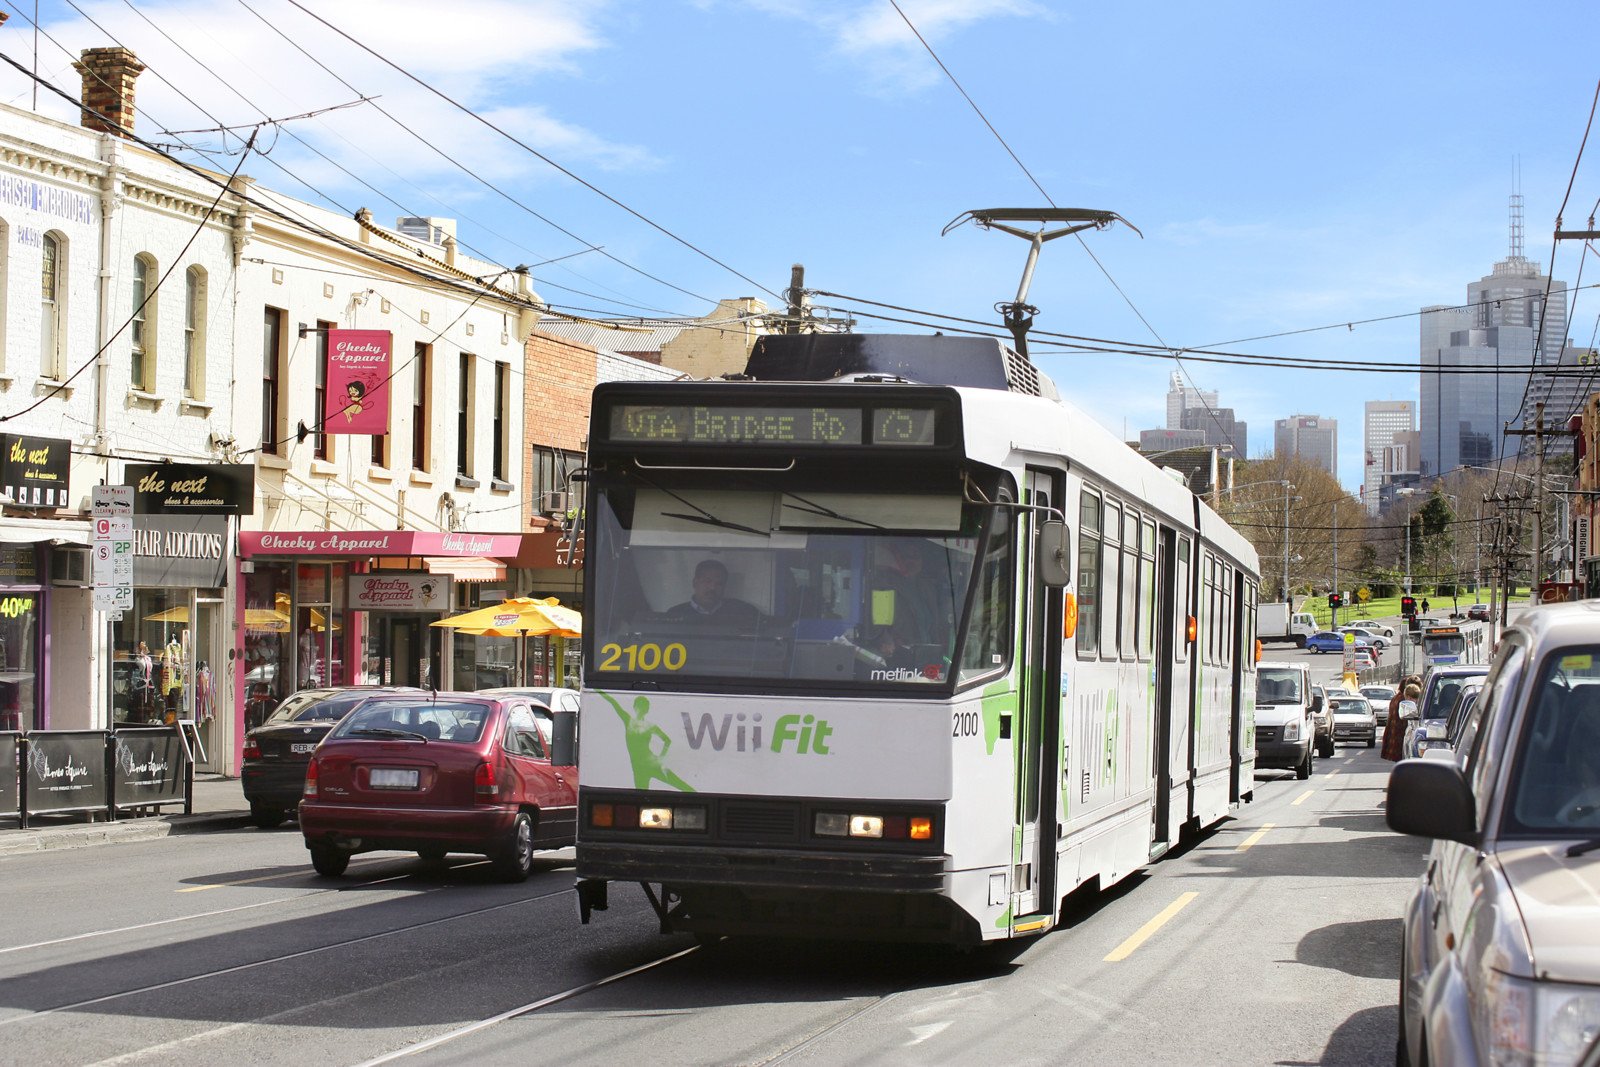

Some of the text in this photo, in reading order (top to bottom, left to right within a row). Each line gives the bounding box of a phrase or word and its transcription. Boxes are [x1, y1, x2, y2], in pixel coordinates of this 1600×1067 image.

[37, 183, 93, 224] EMBROIDERY
[331, 352, 387, 363] Apparel
[336, 342, 382, 354] Cheeky
[627, 413, 677, 438] VIA
[881, 408, 913, 438] 75
[11, 438, 50, 466] the next
[138, 471, 208, 494] the next
[164, 496, 181, 505] shoes
[99, 520, 107, 533] C
[115, 542, 131, 554] 2P
[132, 529, 222, 559] HAIR ADDITIONS
[260, 535, 389, 551] Cheeky Apparel
[441, 534, 494, 555] Cheeky Apparel
[1579, 518, 1588, 561] ABORIGINAL
[115, 588, 131, 599] 2P
[363, 578, 410, 591] Cheeky
[359, 589, 414, 603] Apparel
[598, 643, 687, 671] 2100
[870, 667, 923, 681] metlink
[681, 711, 834, 755] Wii Fit
[952, 711, 979, 738] 2100
